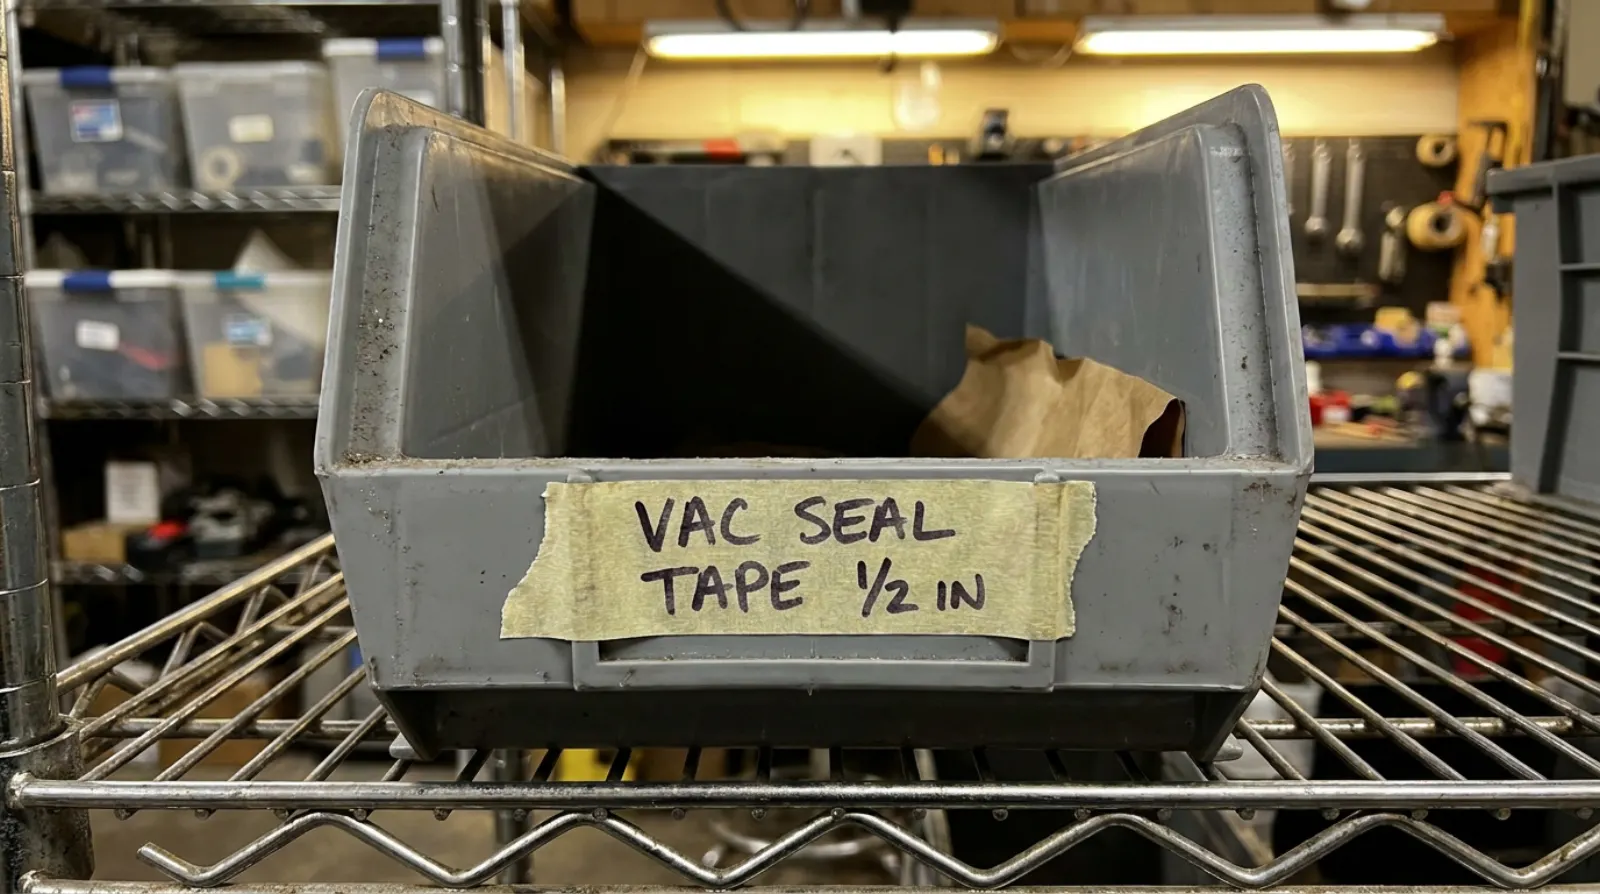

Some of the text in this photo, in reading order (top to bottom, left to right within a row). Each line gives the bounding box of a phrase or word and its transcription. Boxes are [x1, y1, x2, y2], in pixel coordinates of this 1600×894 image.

[634, 495, 956, 553] VAC SEAL
[640, 557, 986, 618] TAPE 1/2 IN
